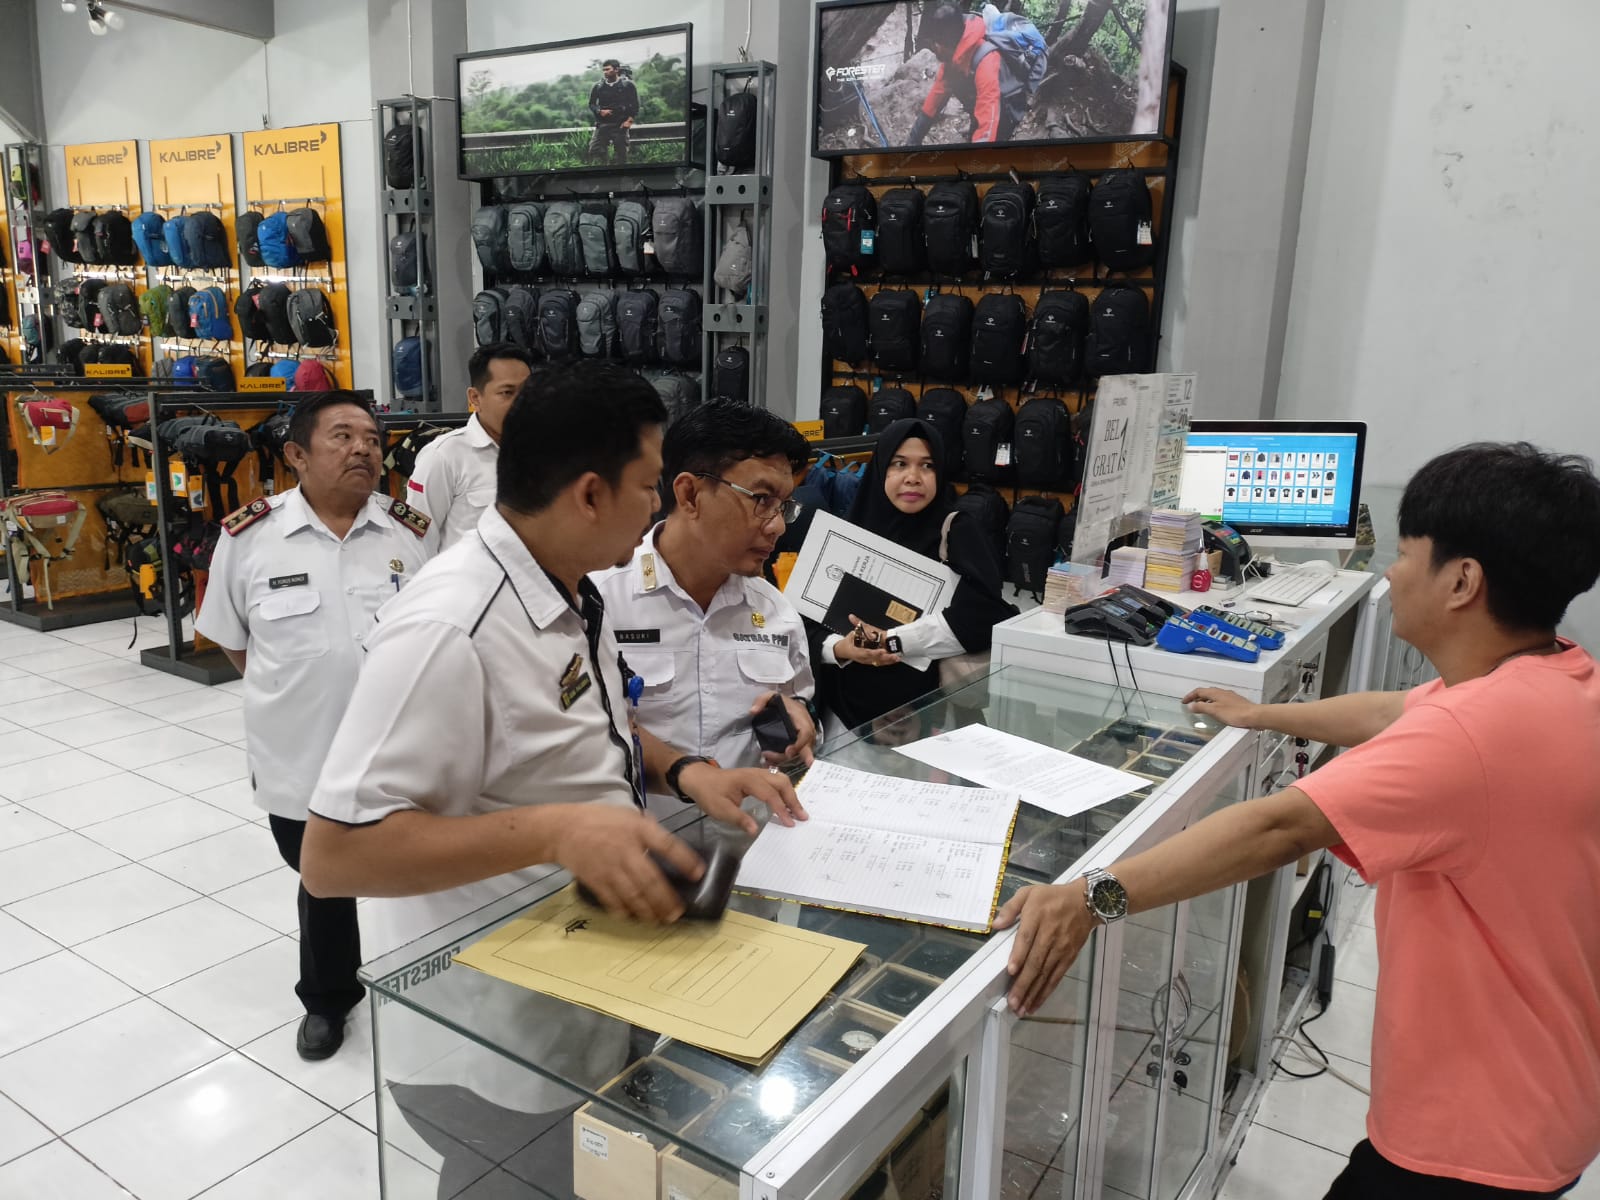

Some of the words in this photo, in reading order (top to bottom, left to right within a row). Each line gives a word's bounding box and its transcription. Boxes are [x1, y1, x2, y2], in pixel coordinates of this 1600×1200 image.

[836, 64, 886, 77] FORESTER
[254, 139, 321, 156] KALIBRE
[73, 153, 123, 166] KALIBRE
[159, 148, 216, 163] KALIBRE
